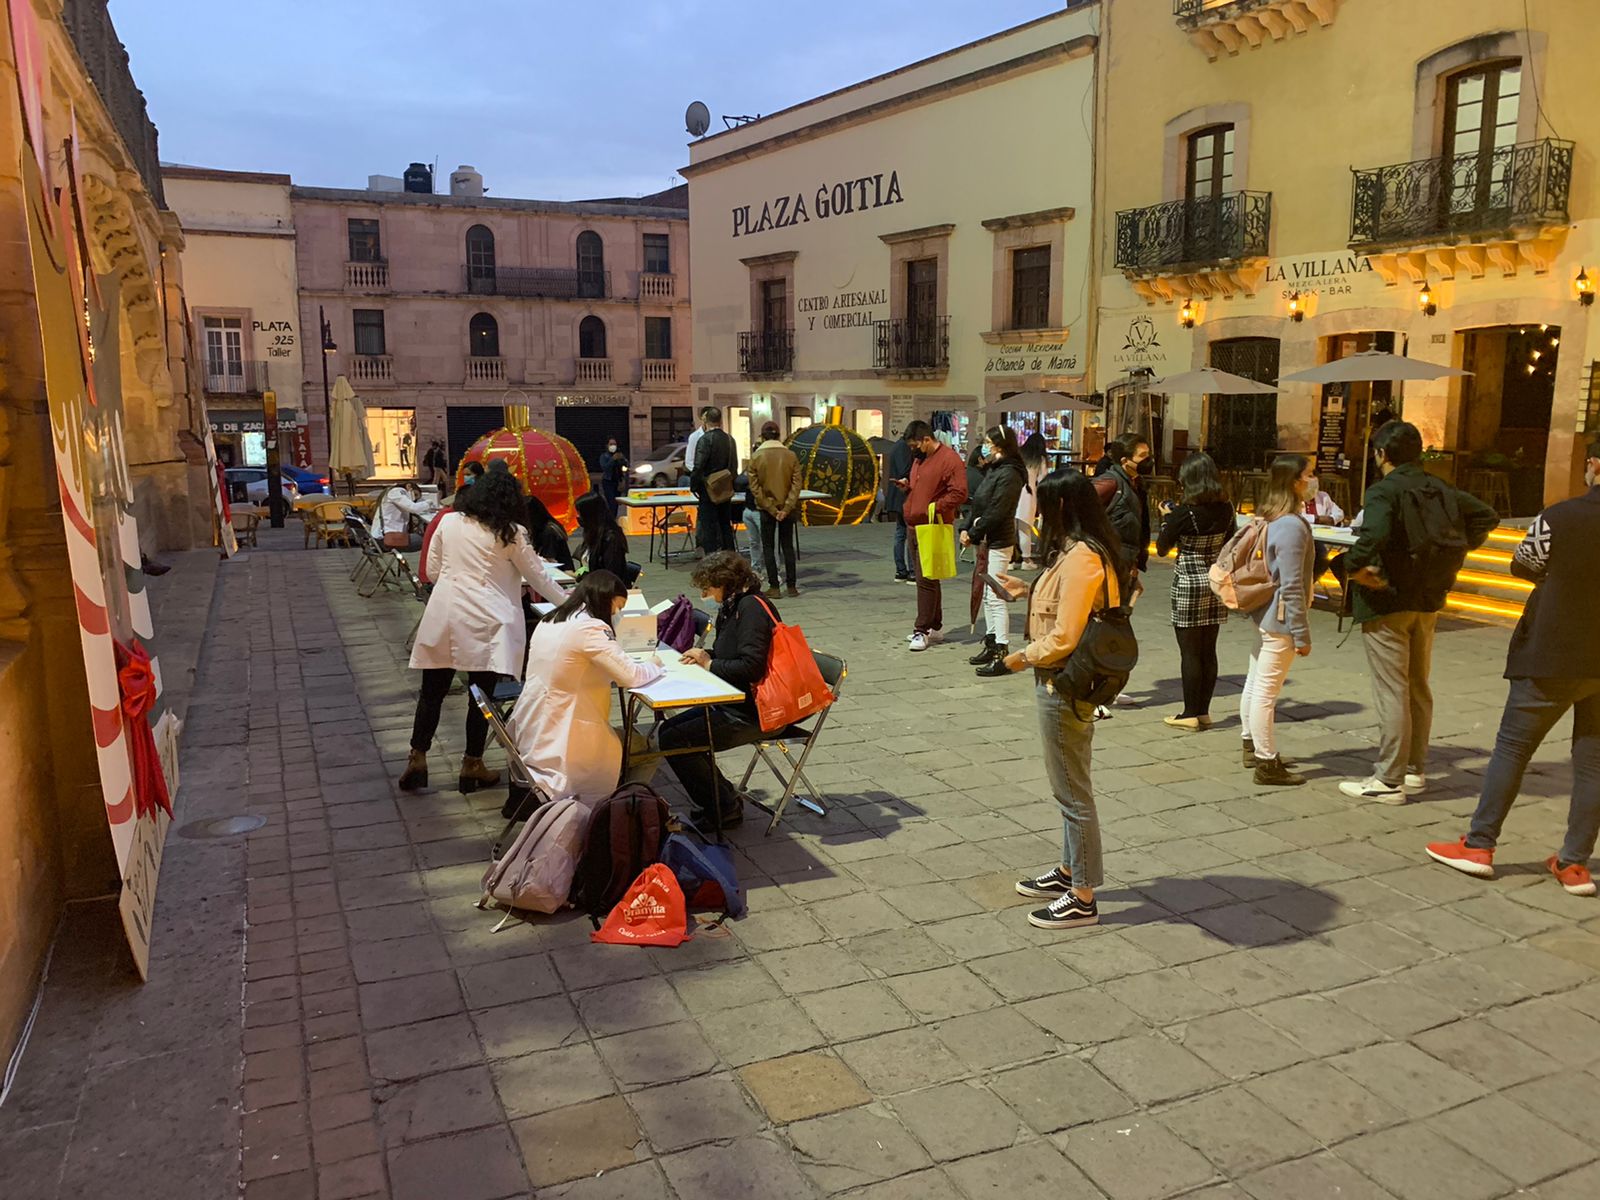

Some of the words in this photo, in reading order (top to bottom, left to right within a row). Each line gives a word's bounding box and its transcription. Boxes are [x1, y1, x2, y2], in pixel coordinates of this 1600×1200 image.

[732, 193, 810, 237] PLAZA
[815, 170, 904, 219] GOITIA
[1265, 266, 1286, 282] LA
[1292, 257, 1374, 278] VILLANA
[1329, 286, 1352, 295] BAR
[798, 296, 829, 312] CENTRO
[833, 289, 888, 309] ARTESANAL
[252, 321, 292, 331] PLATA
[808, 316, 816, 331] Y
[823, 311, 873, 329] COMERCIAL
[272, 335, 295, 345] .925
[267, 347, 291, 357] Taller
[1126, 353, 1167, 362] VILLANA
[1031, 357, 1042, 370] de
[1048, 354, 1077, 370] Mamá
[223, 423, 238, 431] DE
[298, 427, 307, 467] PLATA
[623, 907, 666, 924] granvita
